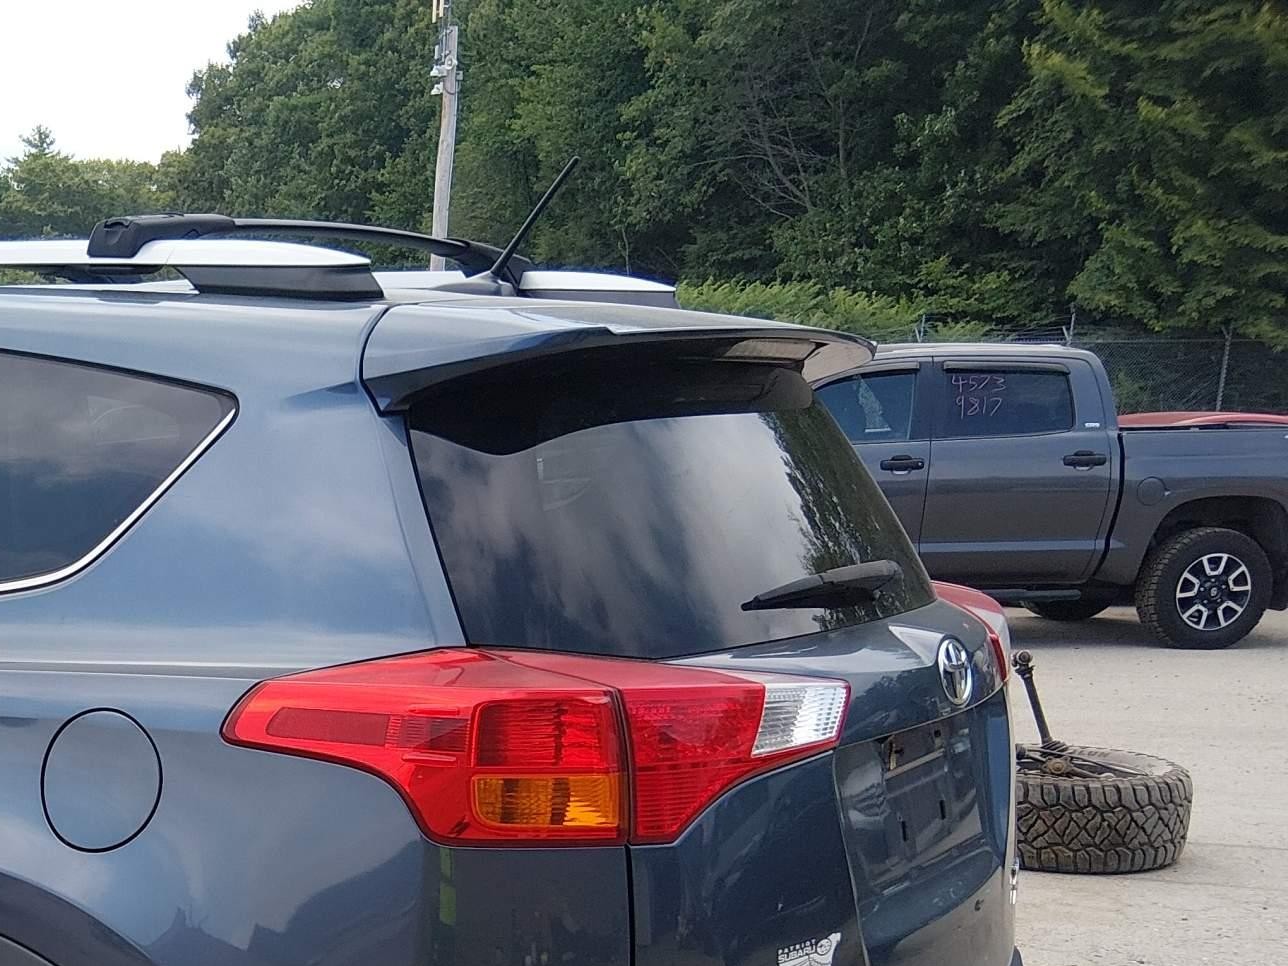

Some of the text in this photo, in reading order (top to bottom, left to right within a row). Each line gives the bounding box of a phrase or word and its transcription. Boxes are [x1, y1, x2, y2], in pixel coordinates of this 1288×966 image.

[951, 374, 1007, 393] 4573
[955, 397, 1003, 420] 9817
[777, 944, 816, 964] SUBARU
[778, 938, 817, 955] PATRIOT
